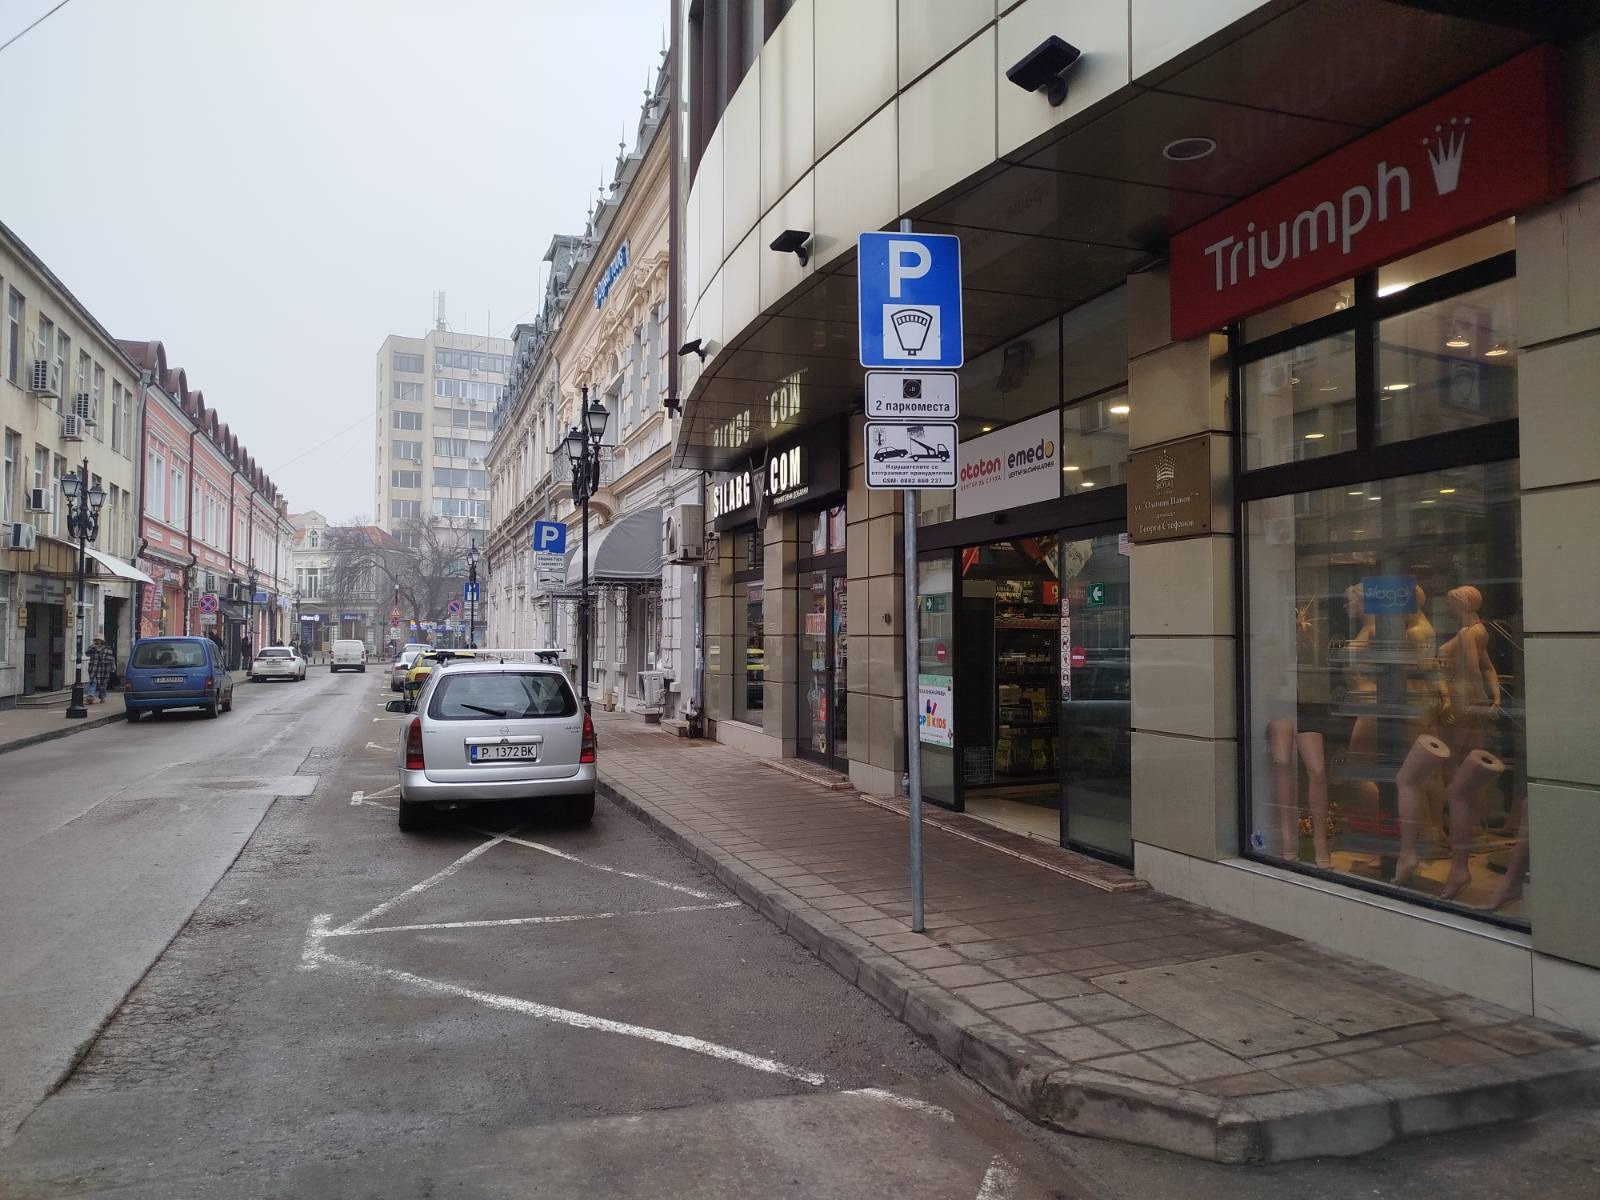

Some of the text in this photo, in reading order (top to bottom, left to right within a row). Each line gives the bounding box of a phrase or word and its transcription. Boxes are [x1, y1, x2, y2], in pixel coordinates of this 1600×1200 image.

[1204, 161, 1411, 292] Triumph
[888, 240, 932, 298] P
[875, 401, 950, 414] 2 паркоместа
[1007, 438, 1055, 469] emedo
[960, 457, 1002, 481] ototon
[713, 471, 750, 518] SILABG
[541, 526, 559, 548] P
[495, 746, 519, 758] 1372
